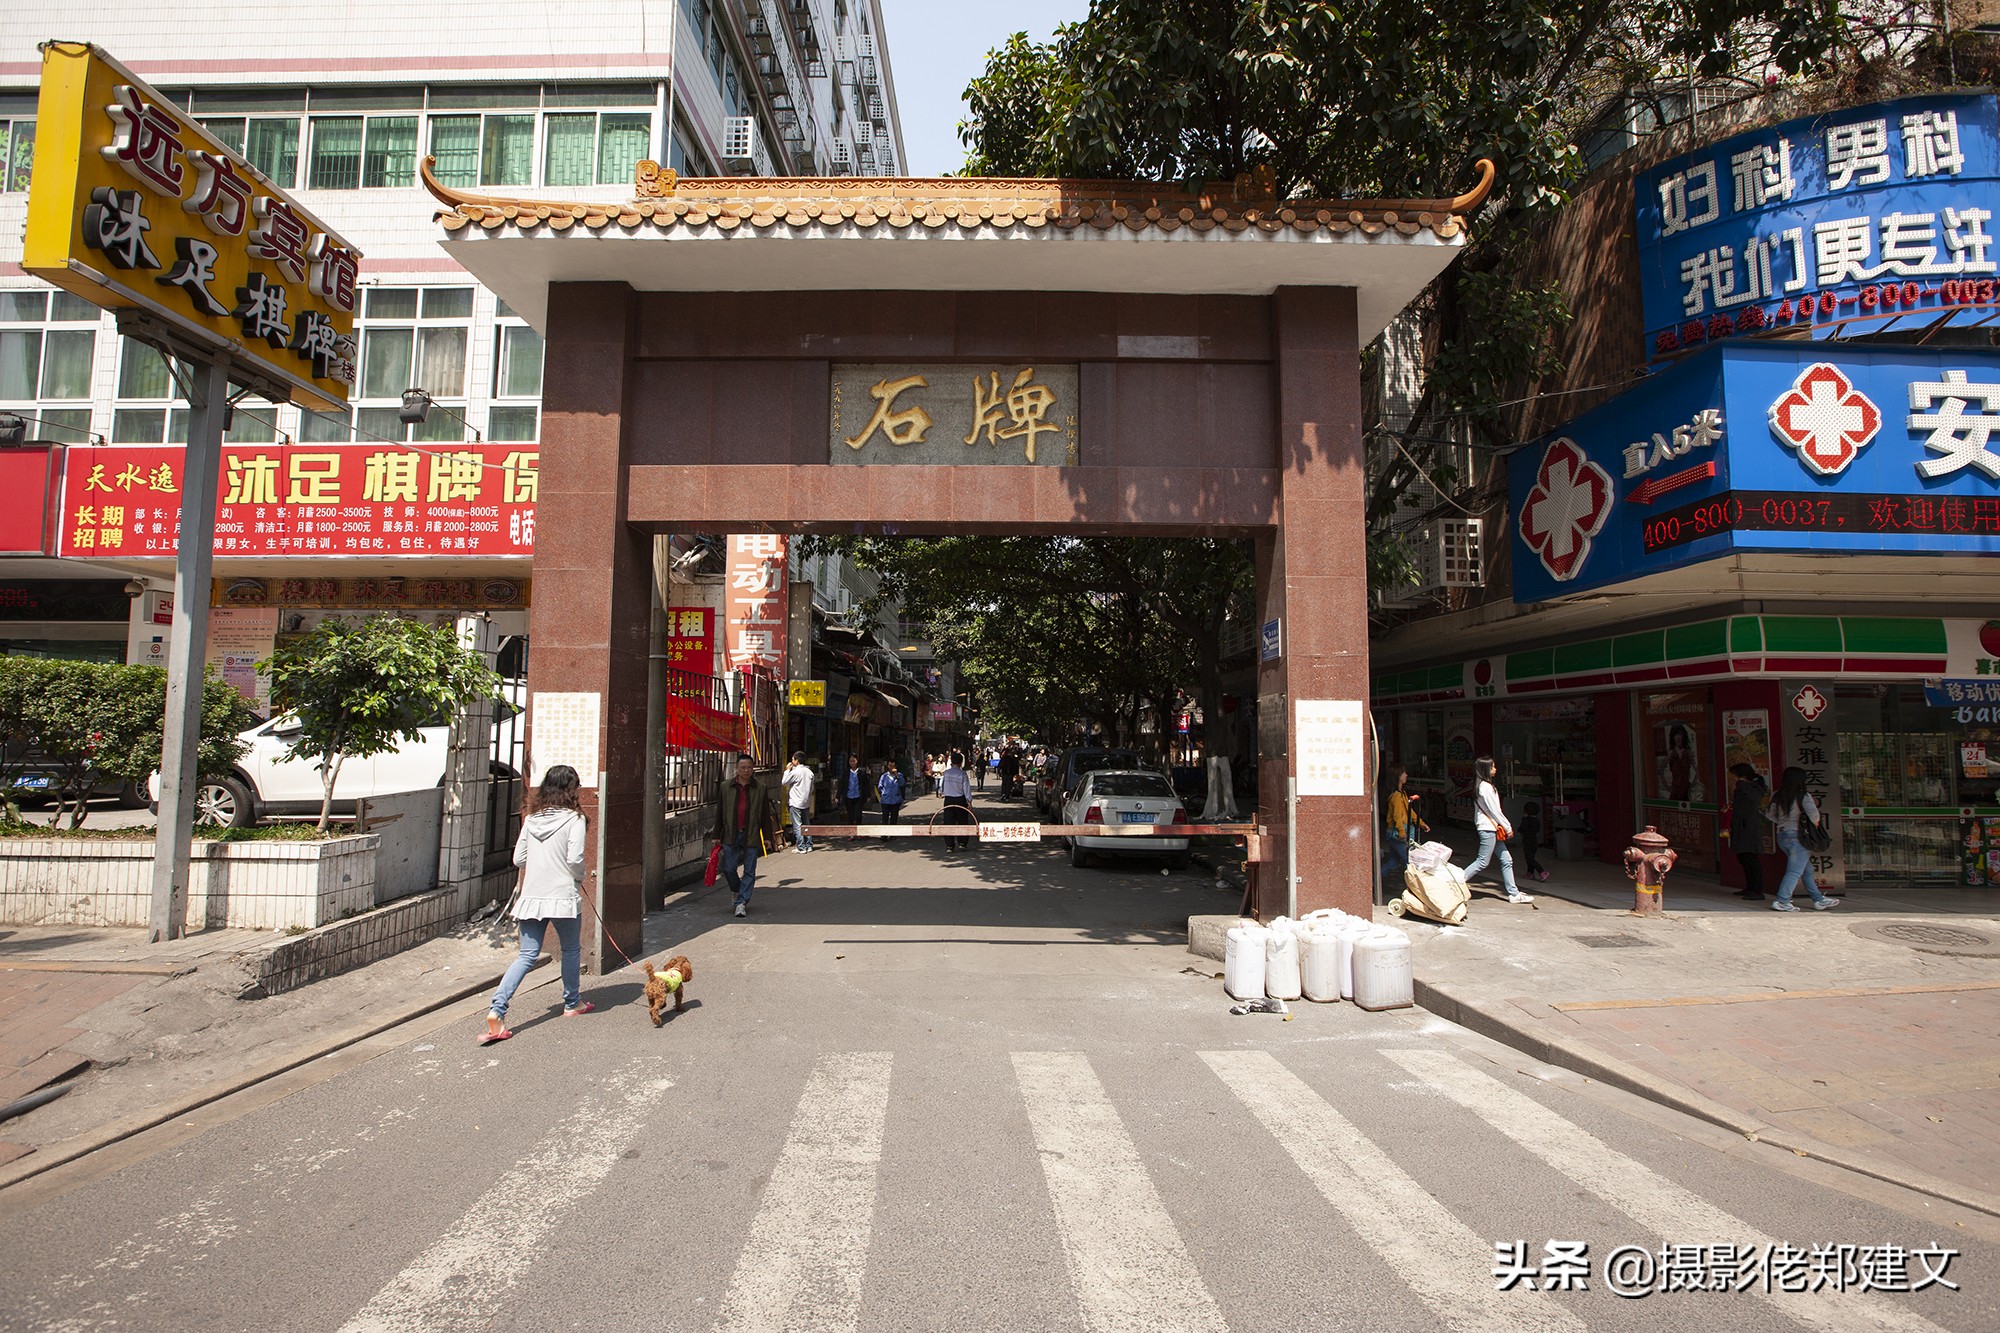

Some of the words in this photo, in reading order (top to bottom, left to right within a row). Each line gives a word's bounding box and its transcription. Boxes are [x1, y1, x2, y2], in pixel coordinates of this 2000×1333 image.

[101, 85, 358, 312] 远方宾馆
[1658, 137, 1796, 238] 妇科
[1826, 110, 1965, 191] 男科
[82, 186, 338, 378] 沐足棋牌
[1681, 206, 1998, 317] 我们更专注
[335, 334, 356, 384] 六楼
[844, 367, 1062, 463] 石牌
[1622, 408, 1723, 480] 直入5米
[1907, 370, 2000, 480] 安
[74, 505, 124, 526] 长期
[83, 461, 179, 494] 天水逸
[223, 453, 341, 505] 沐足
[361, 451, 484, 503] 棋牌
[501, 451, 539, 503] 保
[73, 527, 124, 549] 招聘
[278, 580, 338, 600] 棋牌
[352, 580, 407, 600] 沐足
[730, 534, 785, 663] 电动工具
